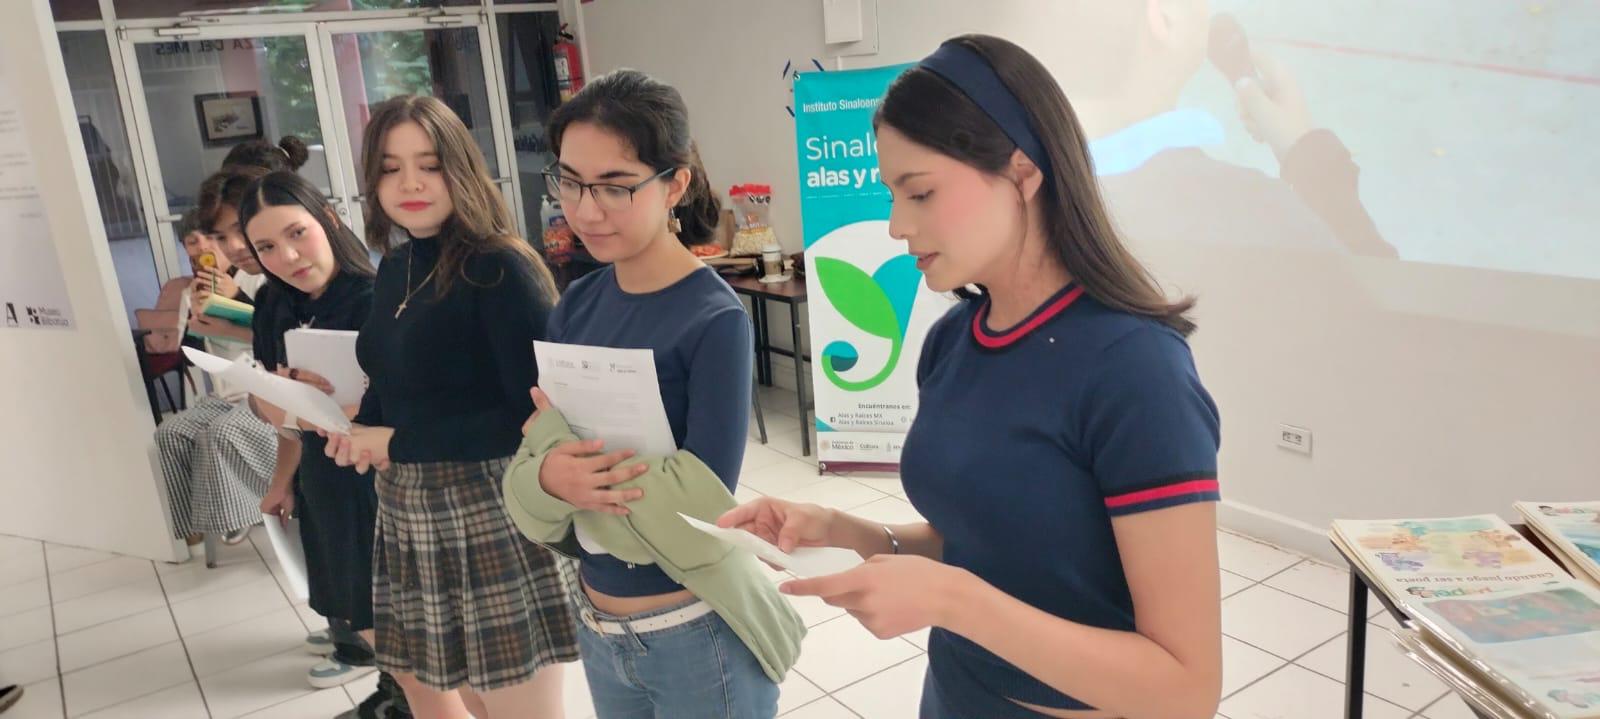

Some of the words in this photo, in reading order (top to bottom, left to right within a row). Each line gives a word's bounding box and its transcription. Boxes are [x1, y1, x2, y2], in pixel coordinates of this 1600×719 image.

[802, 101, 838, 113] Instituto
[806, 131, 878, 161] Sinal
[806, 166, 850, 187] alas
[853, 167, 867, 189] y
[1504, 572, 1555, 583] Cuando
